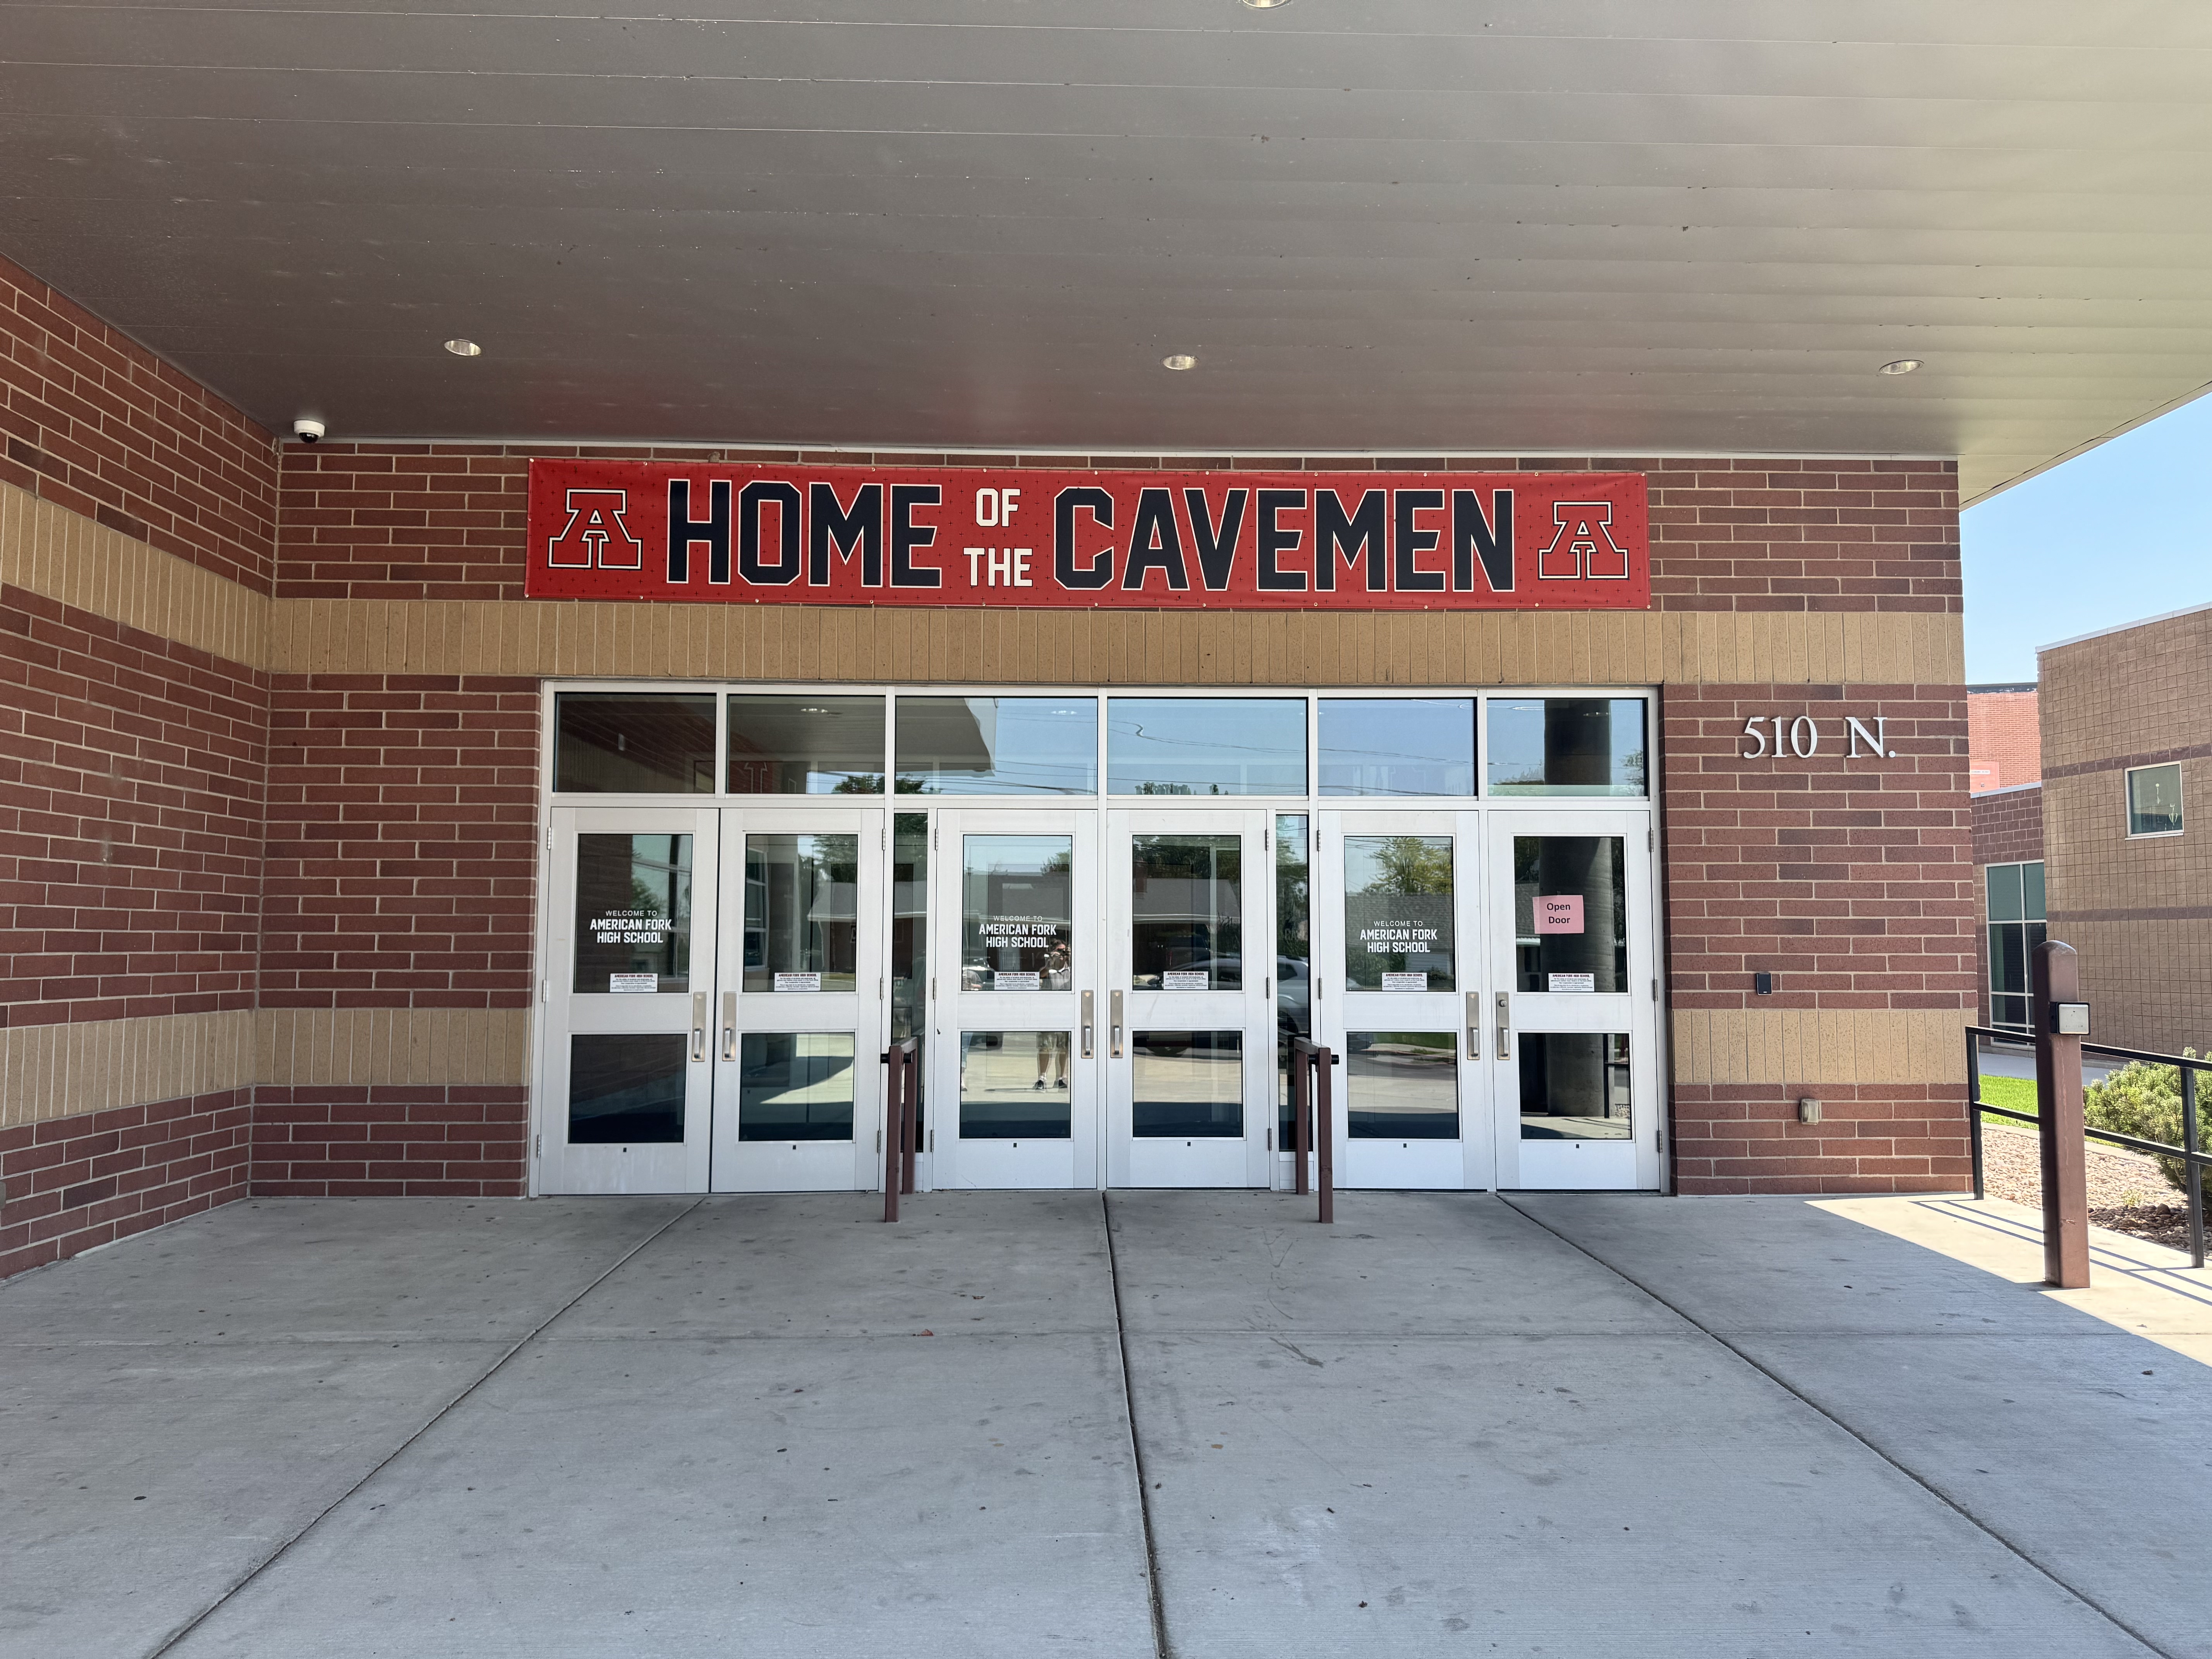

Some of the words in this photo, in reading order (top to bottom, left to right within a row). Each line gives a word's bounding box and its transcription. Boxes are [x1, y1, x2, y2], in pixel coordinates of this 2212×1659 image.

[975, 487, 1022, 528] OF
[547, 488, 643, 570] A
[666, 478, 942, 589] HOME
[1054, 486, 1515, 593] CAVEMEN
[1538, 500, 1629, 580] A
[963, 547, 1034, 587] THE
[1743, 715, 1818, 759] 510
[1845, 716, 1896, 758] N.
[1547, 903, 1570, 912] Open
[590, 919, 642, 930] AMERICAN
[645, 919, 672, 930] FORK
[597, 932, 620, 943] HIGH
[623, 932, 663, 943] SCHOOL
[979, 924, 1028, 935] AMERICAN
[1032, 924, 1056, 935] FORK
[1360, 929, 1409, 940] AMERICAN
[1412, 929, 1437, 940] FORK
[986, 936, 1008, 947] HIGH
[1011, 937, 1049, 948] SCHOOL
[1367, 942, 1389, 953] HIGH
[1392, 942, 1431, 953] SCHOOL
